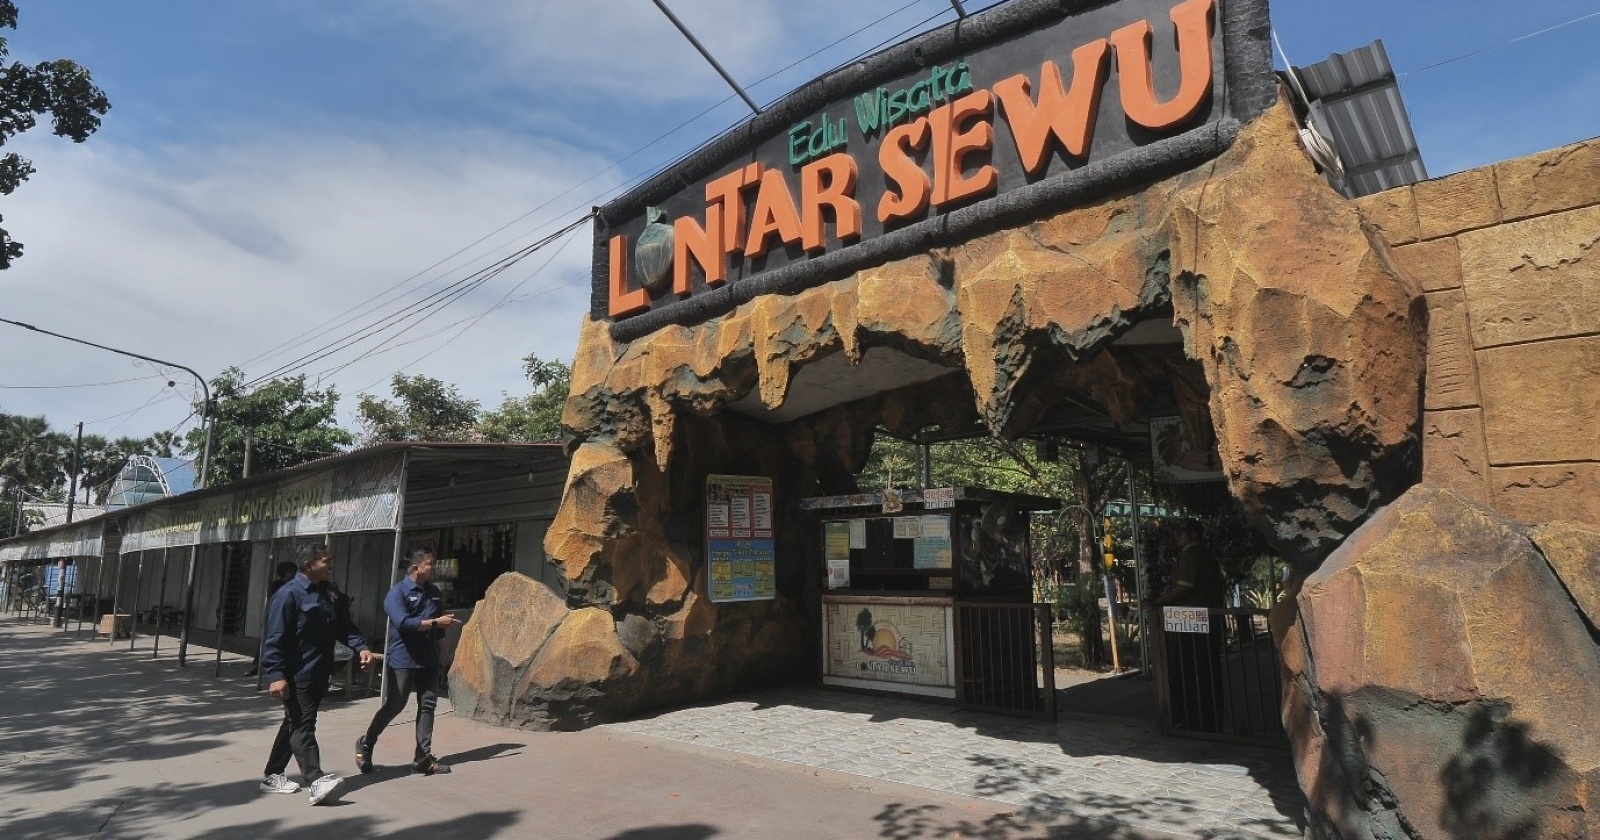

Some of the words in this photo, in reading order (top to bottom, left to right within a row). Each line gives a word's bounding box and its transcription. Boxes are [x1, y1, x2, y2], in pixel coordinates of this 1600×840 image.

[788, 121, 848, 167] Edu
[854, 61, 972, 141] Wisata
[876, 0, 1215, 224] SEWU
[236, 494, 283, 524] LONTAR
[283, 487, 326, 518] SEWU
[925, 498, 954, 508] brilian
[1165, 608, 1195, 620] desa
[1165, 618, 1208, 632] brilian
[889, 665, 917, 676] SEWU
